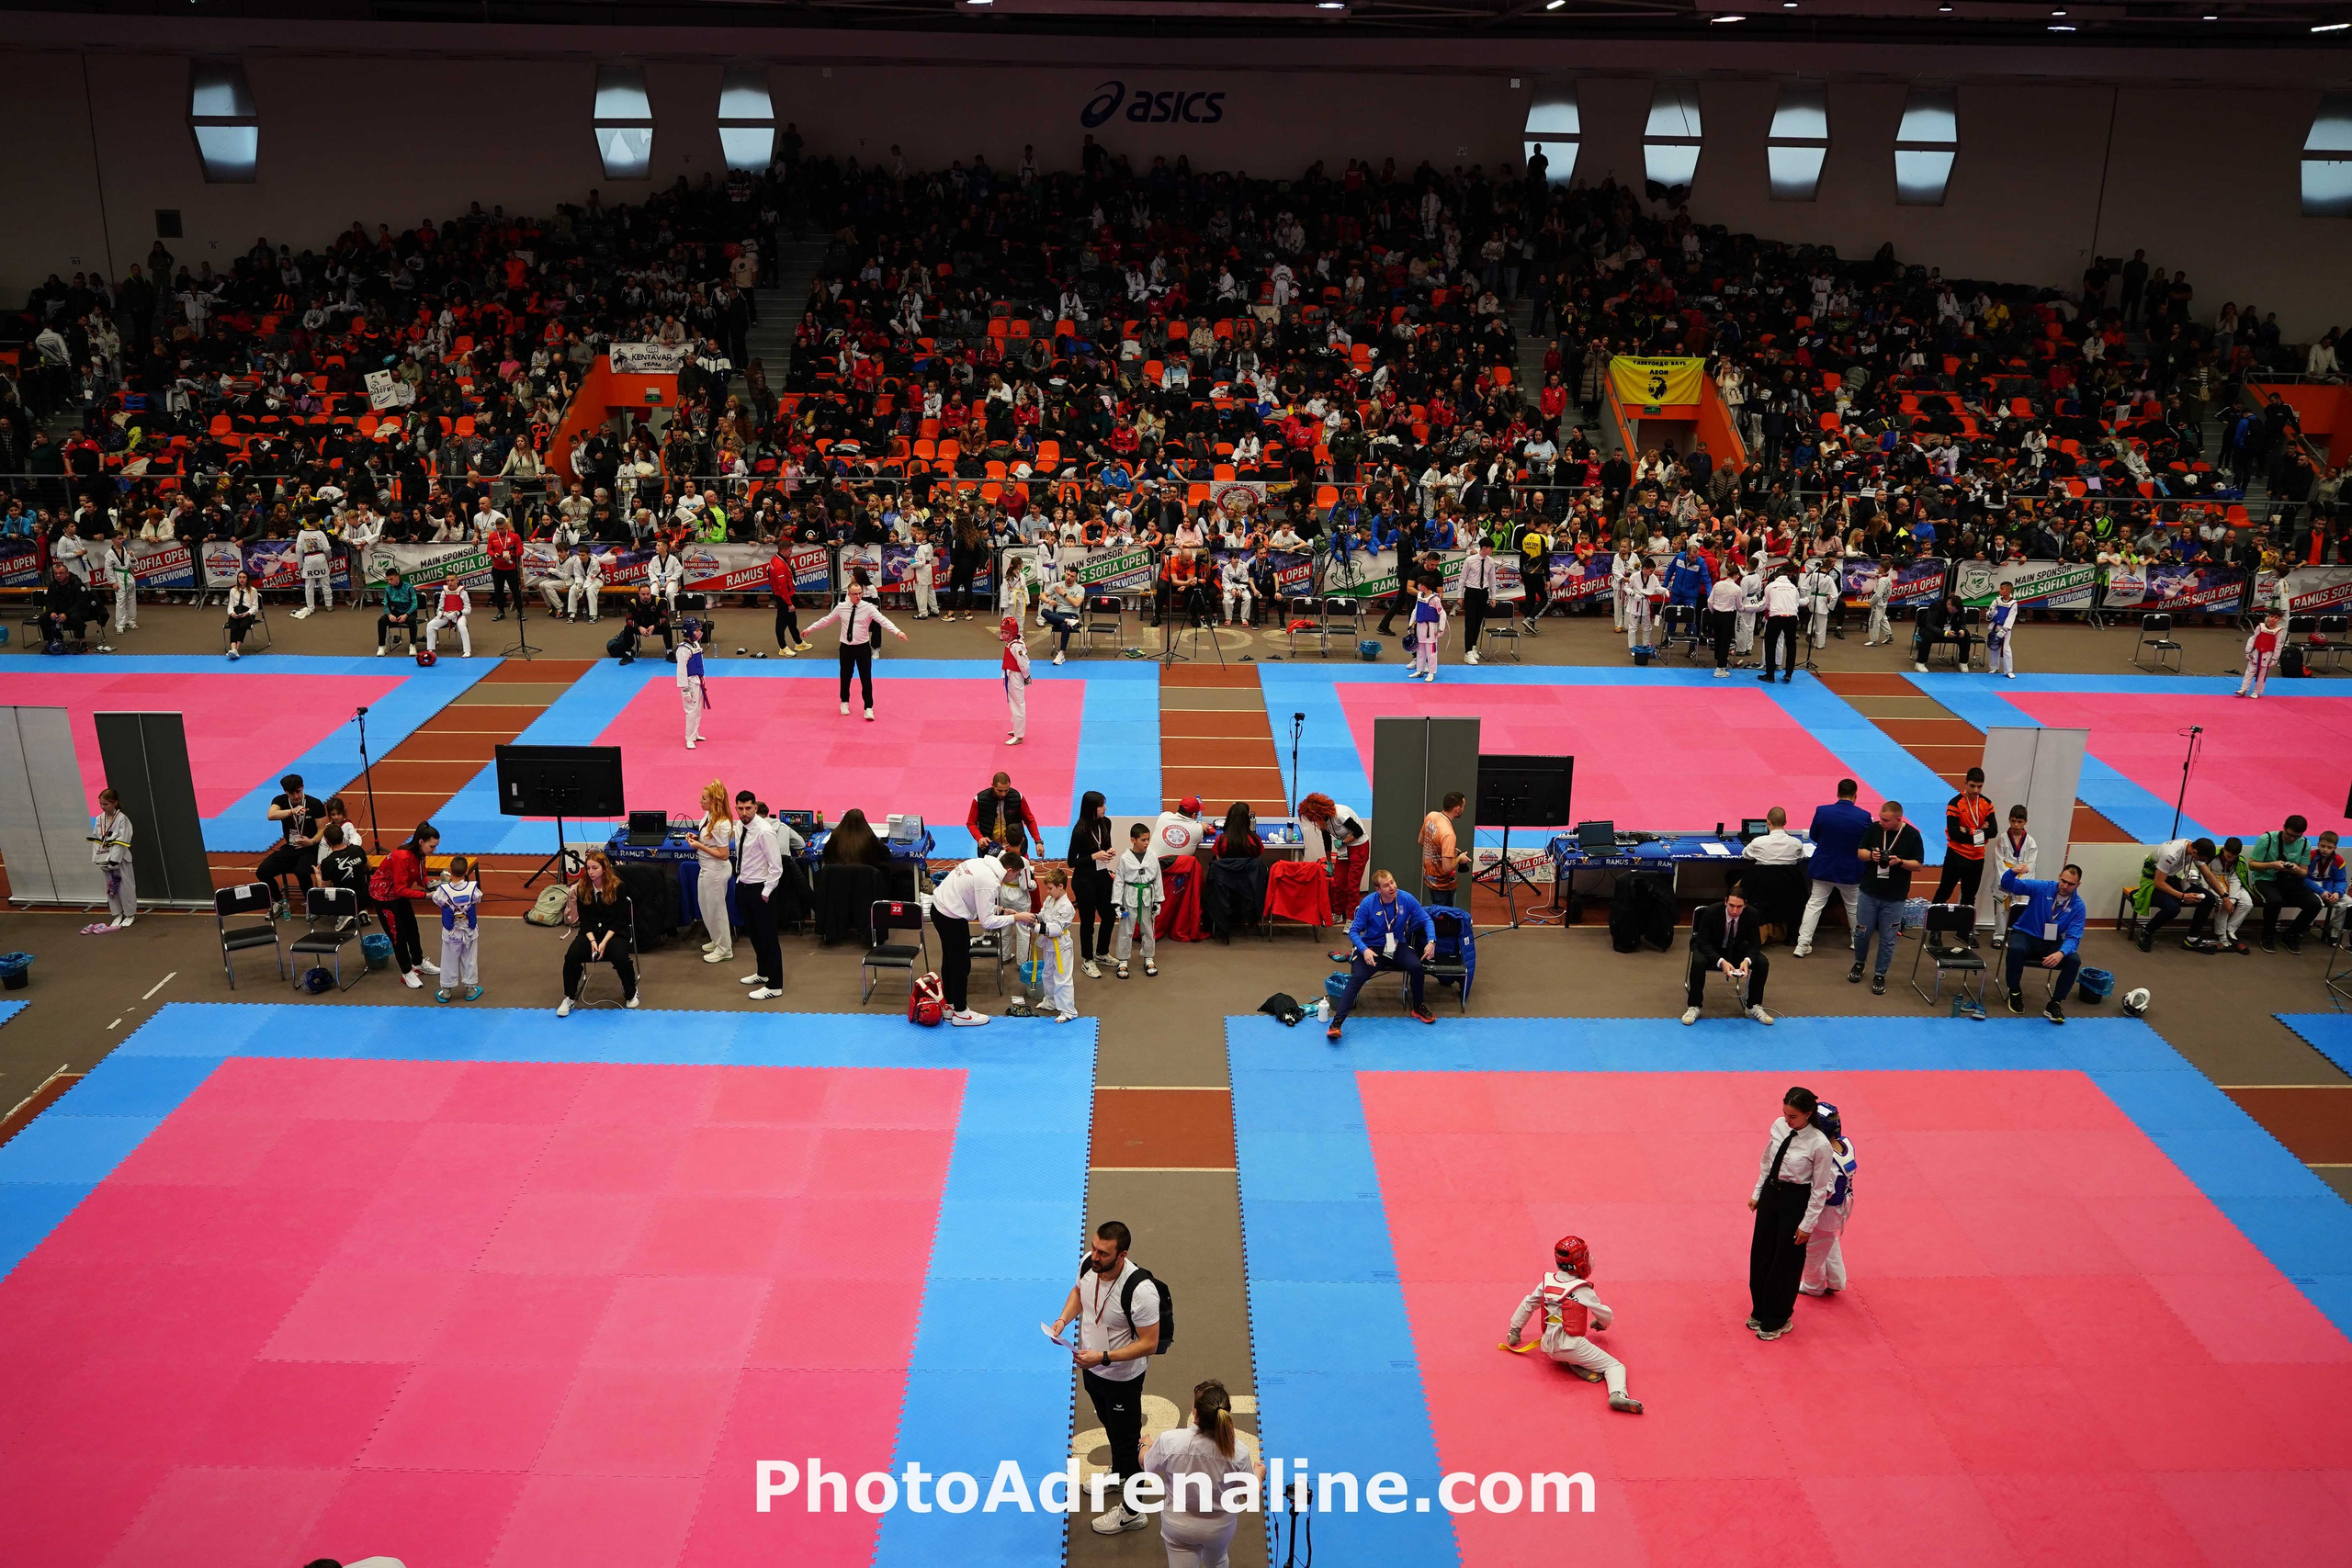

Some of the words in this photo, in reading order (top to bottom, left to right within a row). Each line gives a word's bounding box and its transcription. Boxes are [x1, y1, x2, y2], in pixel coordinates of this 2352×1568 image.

[1126, 91, 1226, 123] asics
[13, 555, 36, 570] OPEN
[165, 548, 191, 564] OPEN
[421, 557, 441, 570] MAIN
[443, 546, 479, 563] SPONSOR
[1087, 548, 1123, 568] SPONSOR
[149, 567, 194, 585] TAEKWONDO
[262, 574, 295, 588] RAMUS
[330, 558, 346, 571] PEN
[409, 568, 444, 584] RAMUS
[447, 558, 476, 573] SOFIA
[615, 567, 639, 581] SOFIA
[726, 567, 763, 587] RAMUS
[800, 550, 827, 568] OPEN
[1090, 561, 1119, 581] SOFIA
[1122, 553, 1148, 570] OPEN
[1286, 565, 1310, 581] OPEN
[2015, 573, 2035, 586] MAIN
[2037, 564, 2073, 581] SPONSOR
[5, 571, 39, 585] TAEKWONDO
[461, 575, 493, 589] TAEKWO
[794, 569, 828, 586] KWONDO
[1103, 571, 1148, 592] TAEKWONDO
[1373, 578, 1400, 593] RAMU
[1444, 561, 1464, 575] OPE
[1892, 582, 1917, 596] SOFIA
[1919, 574, 1941, 591] OPEN
[2038, 580, 2066, 596] SOFIA
[2069, 570, 2096, 585] OPEN
[1552, 582, 1578, 600] AMUS
[1580, 578, 1606, 593] SOFIA
[2047, 589, 2092, 607] TAEKWONDO
[2156, 595, 2190, 610] RAMUS
[2192, 590, 2216, 604] SOFIA
[2218, 583, 2242, 598] OPEN
[2206, 599, 2239, 613] TAEKWONDO
[2293, 592, 2330, 608] RAMUS
[346, 857, 362, 867] TEAM
[568, 850, 581, 874] 3
[620, 849, 645, 857] RAMUS
[673, 852, 698, 860] RAMUS
[1533, 855, 1554, 866] OPEN
